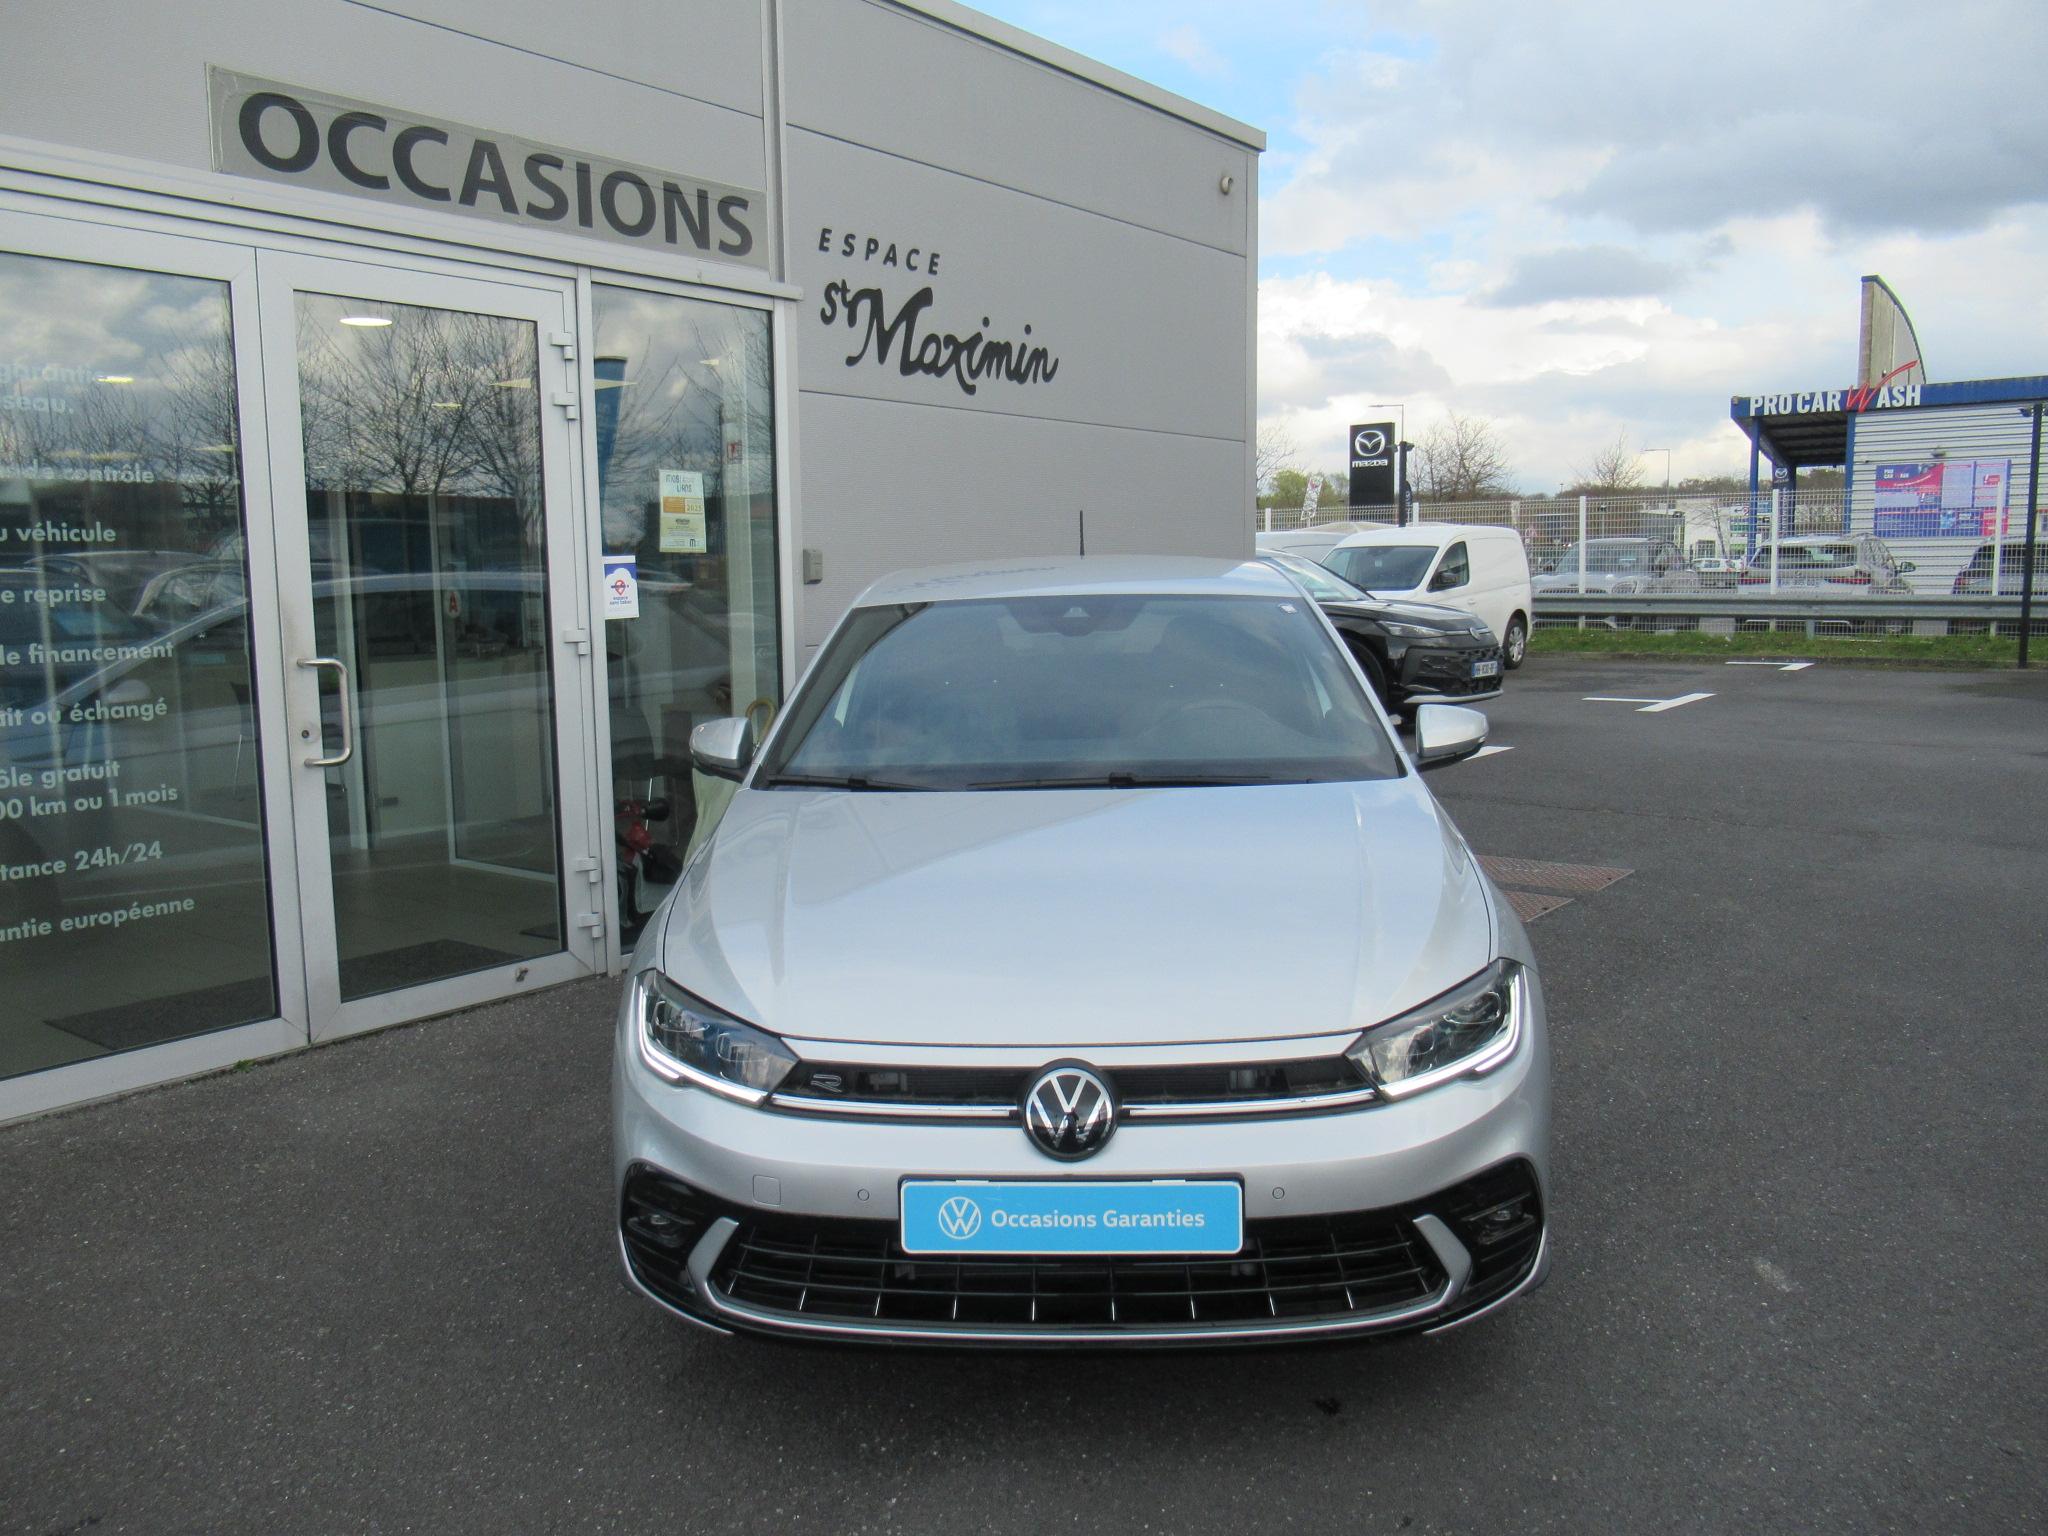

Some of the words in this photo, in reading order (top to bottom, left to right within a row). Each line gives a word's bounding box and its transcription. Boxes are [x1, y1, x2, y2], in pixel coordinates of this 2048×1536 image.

[239, 92, 753, 257] OCCASIONS
[818, 228, 940, 275] ESPACE
[845, 287, 1059, 396] Maximin
[1750, 396, 1793, 416] PRO
[1796, 391, 1841, 414] CAR
[16, 521, 117, 542] véhicule
[23, 583, 107, 607] reprise
[28, 641, 174, 664] financement
[31, 710, 61, 725] ou
[70, 696, 168, 723] échangé
[41, 760, 120, 789] gratuit
[31, 796, 67, 817] km
[74, 796, 103, 812] ou
[109, 788, 119, 808] 1
[125, 783, 178, 806] mois
[74, 840, 163, 872] 24h/24
[60, 897, 195, 933] européenne
[991, 1209, 1097, 1228] Occasions
[1103, 1208, 1205, 1228] Garanties
